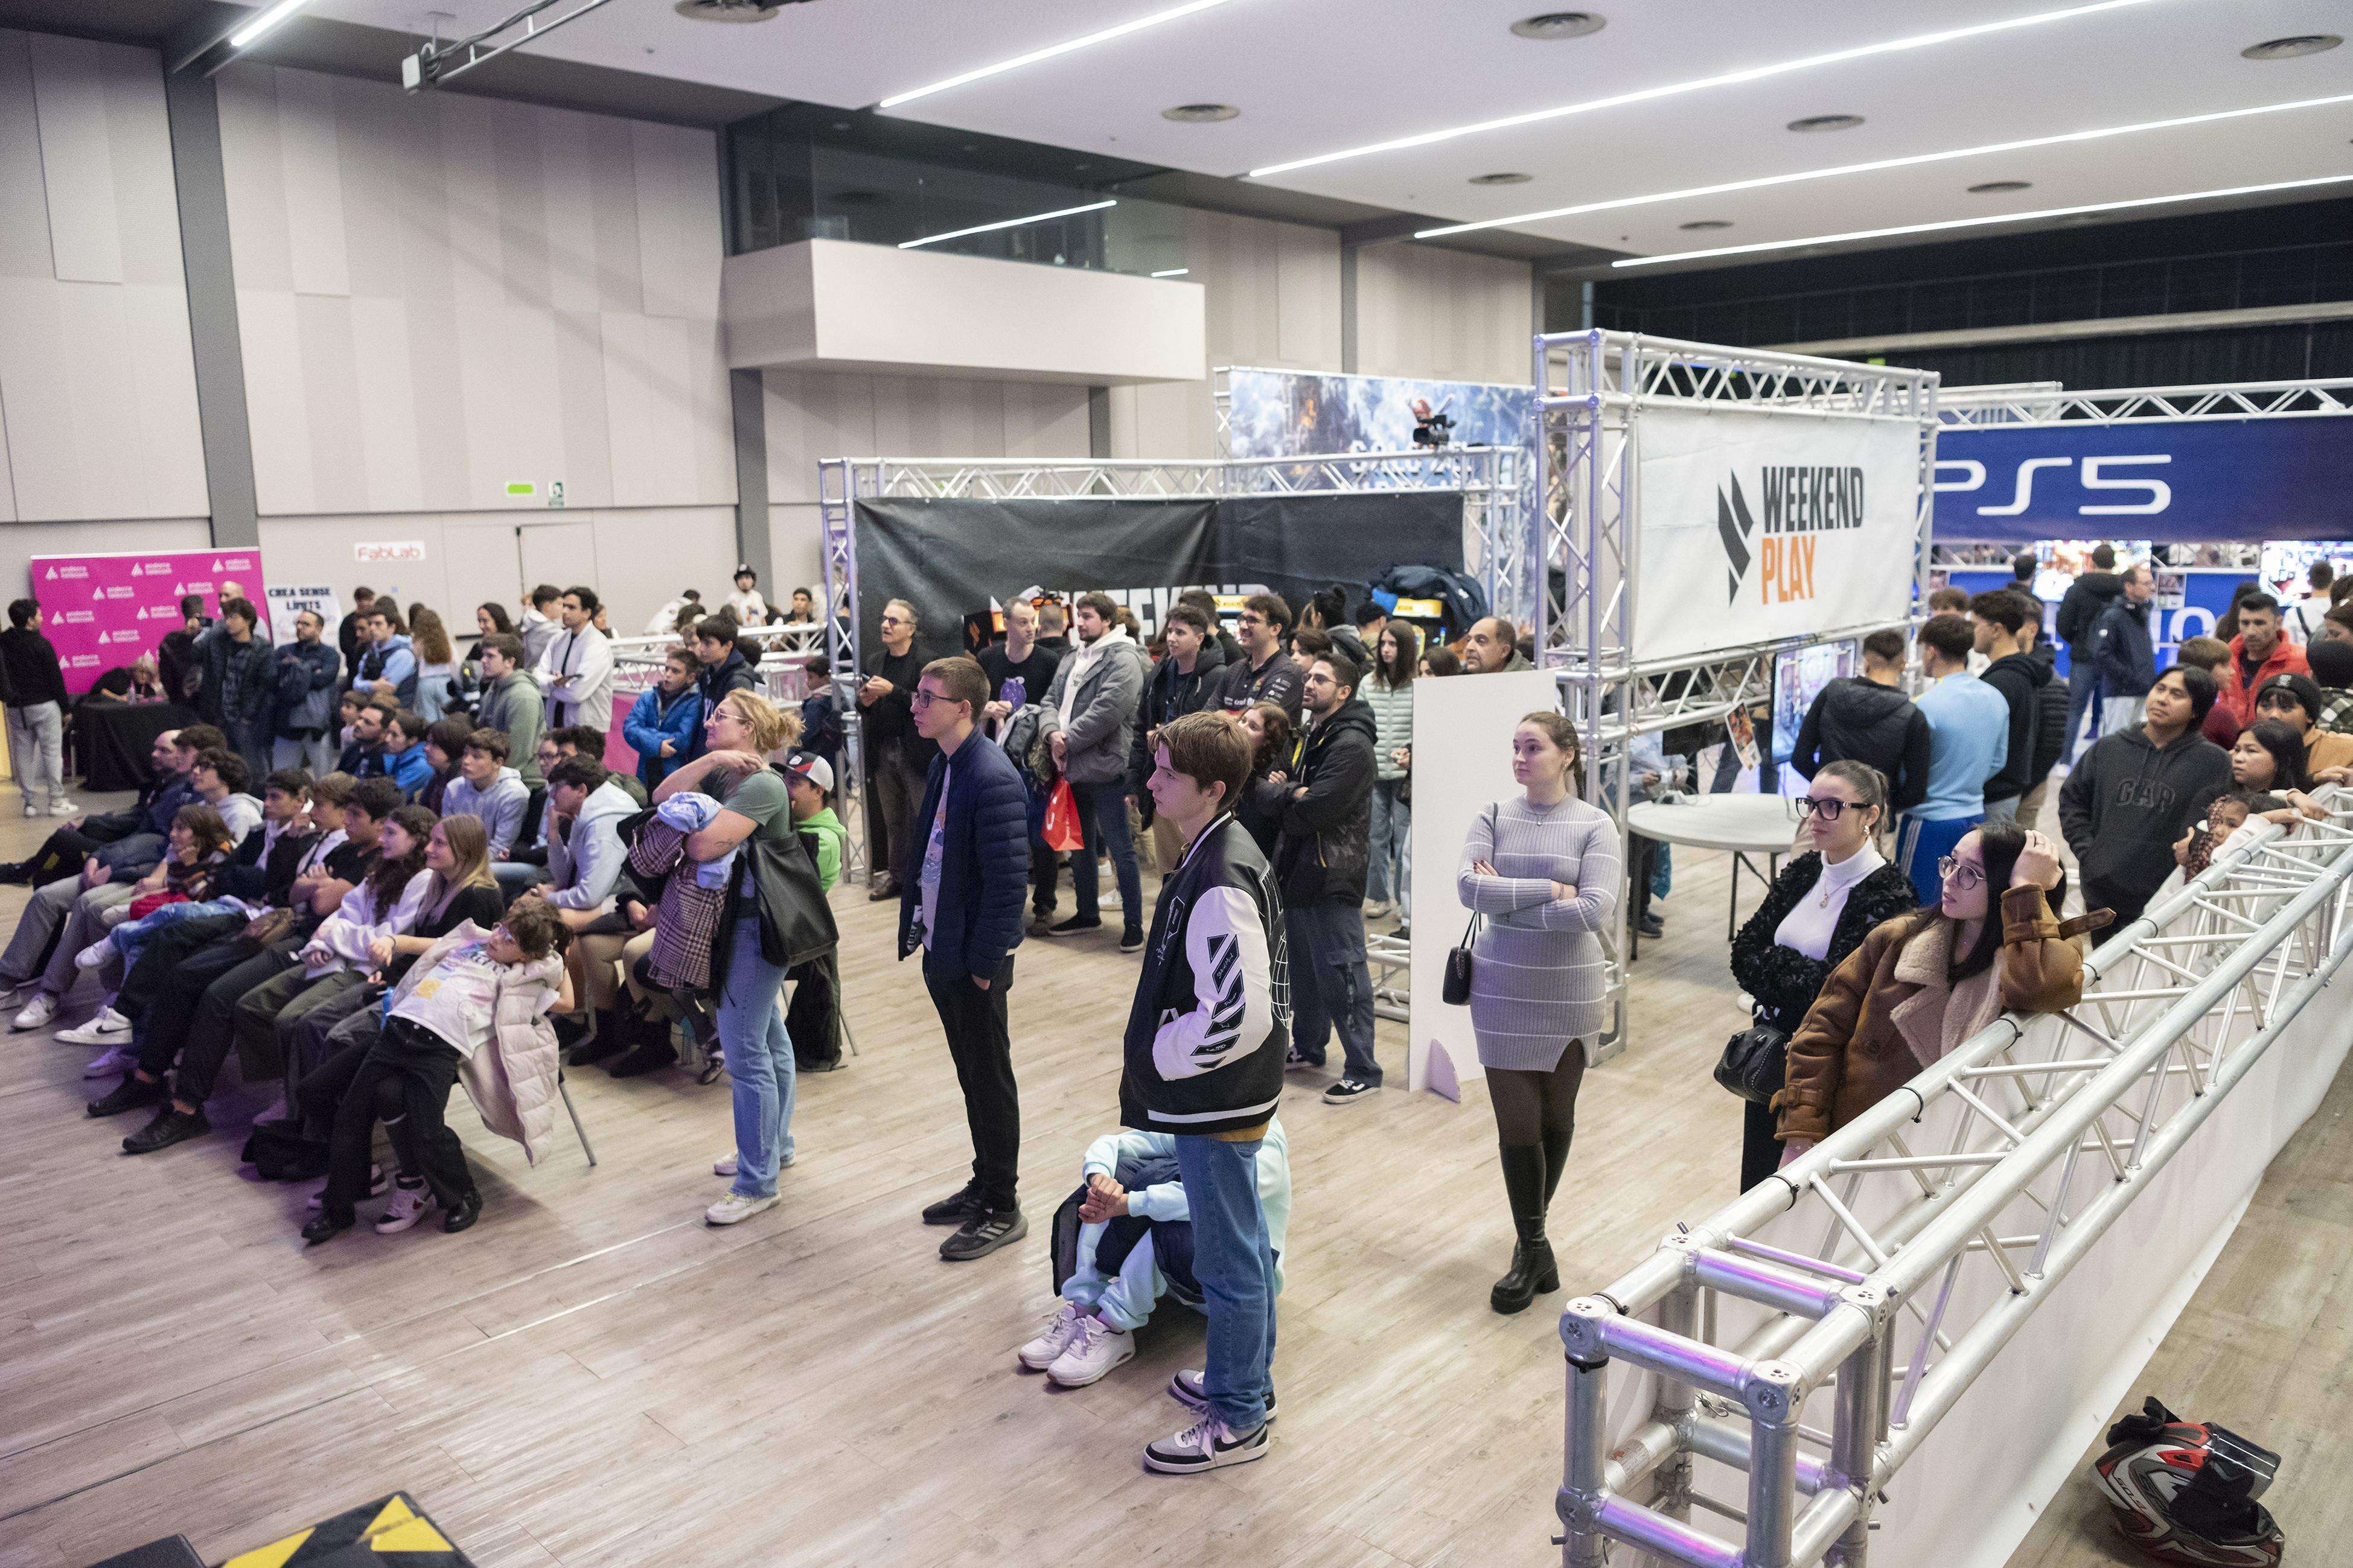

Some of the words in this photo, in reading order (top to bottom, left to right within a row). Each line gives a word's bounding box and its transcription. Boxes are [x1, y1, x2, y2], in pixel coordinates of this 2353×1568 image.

[1762, 466, 1864, 533] WEEKEND
[1918, 454, 2171, 515] PS5
[358, 545, 420, 559] FabLab
[1761, 535, 1816, 605] PLAY
